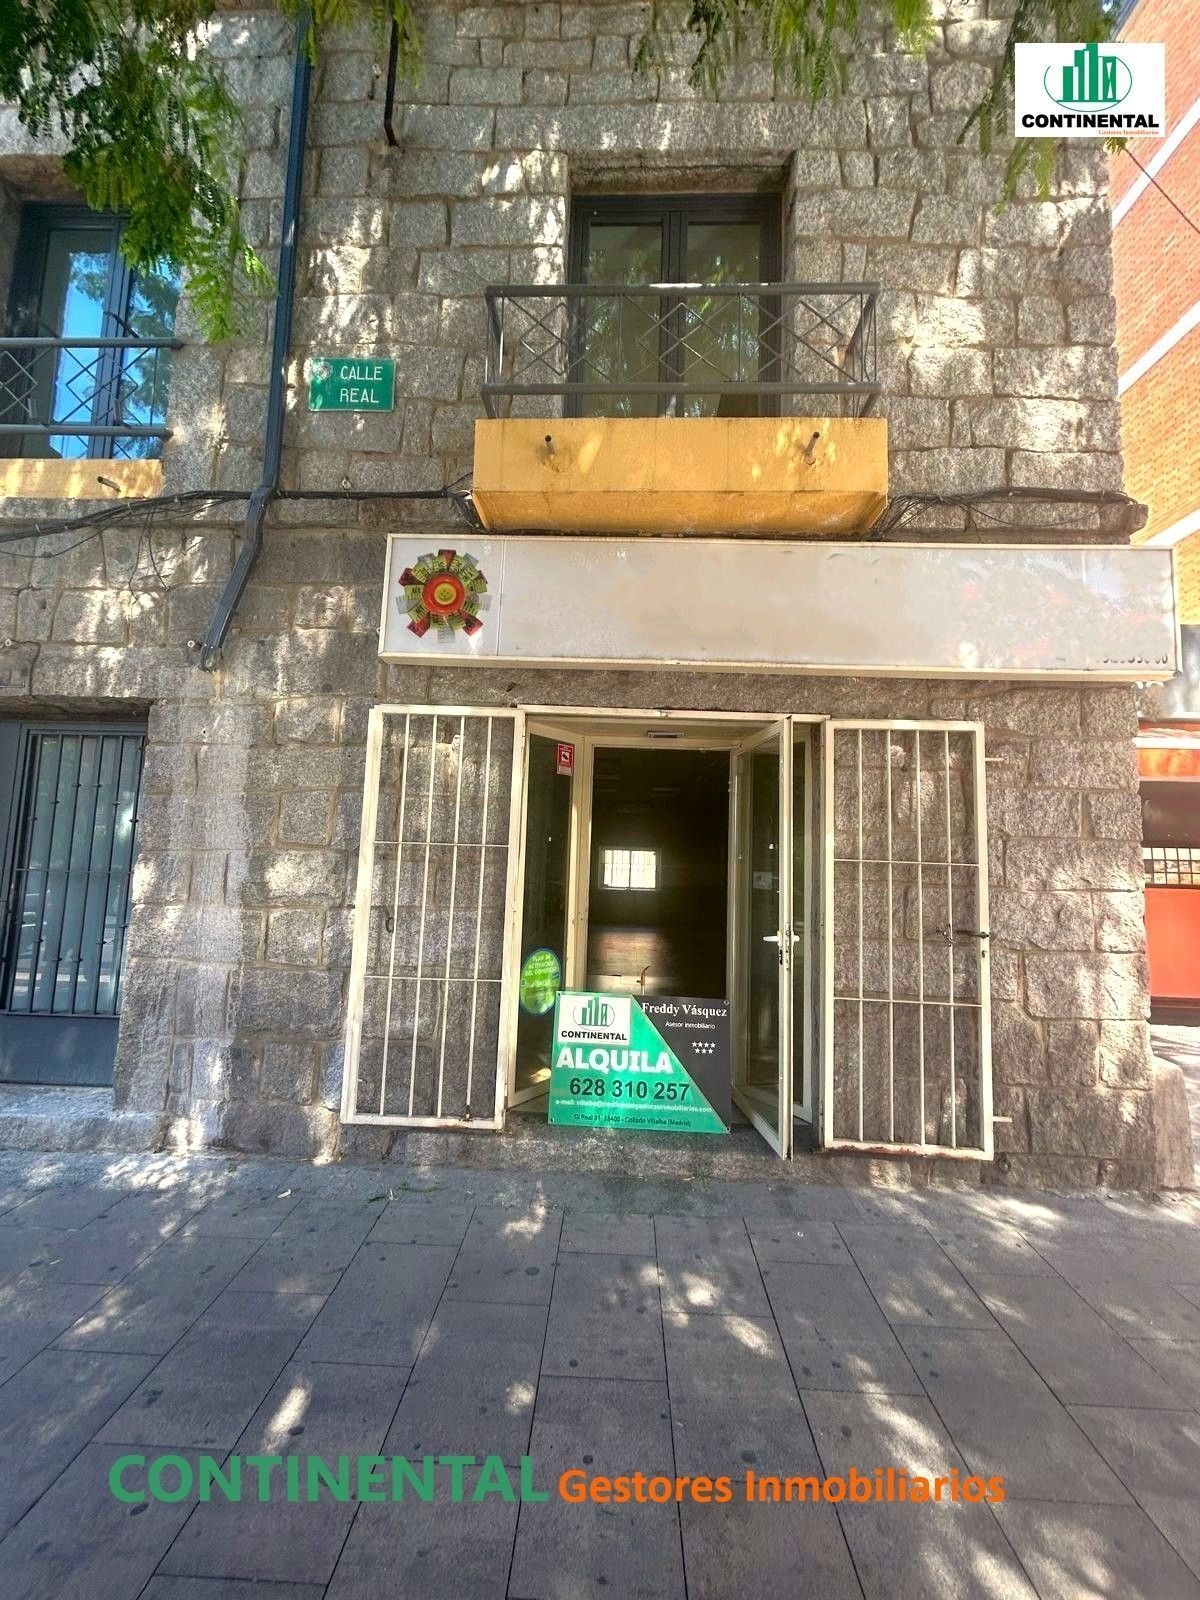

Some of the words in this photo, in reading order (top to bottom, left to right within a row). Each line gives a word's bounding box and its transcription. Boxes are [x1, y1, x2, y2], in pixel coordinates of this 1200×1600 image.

[340, 365, 383, 380] CALLE
[340, 388, 379, 403] REAL
[642, 1002, 680, 1016] Freddy
[682, 1004, 727, 1018] Vásquez
[561, 1030, 627, 1041] CONTINENTAL
[556, 1046, 674, 1074] ALQUILA
[570, 1077, 605, 1096] 628
[612, 1079, 648, 1098] 310
[654, 1081, 689, 1100] 257
